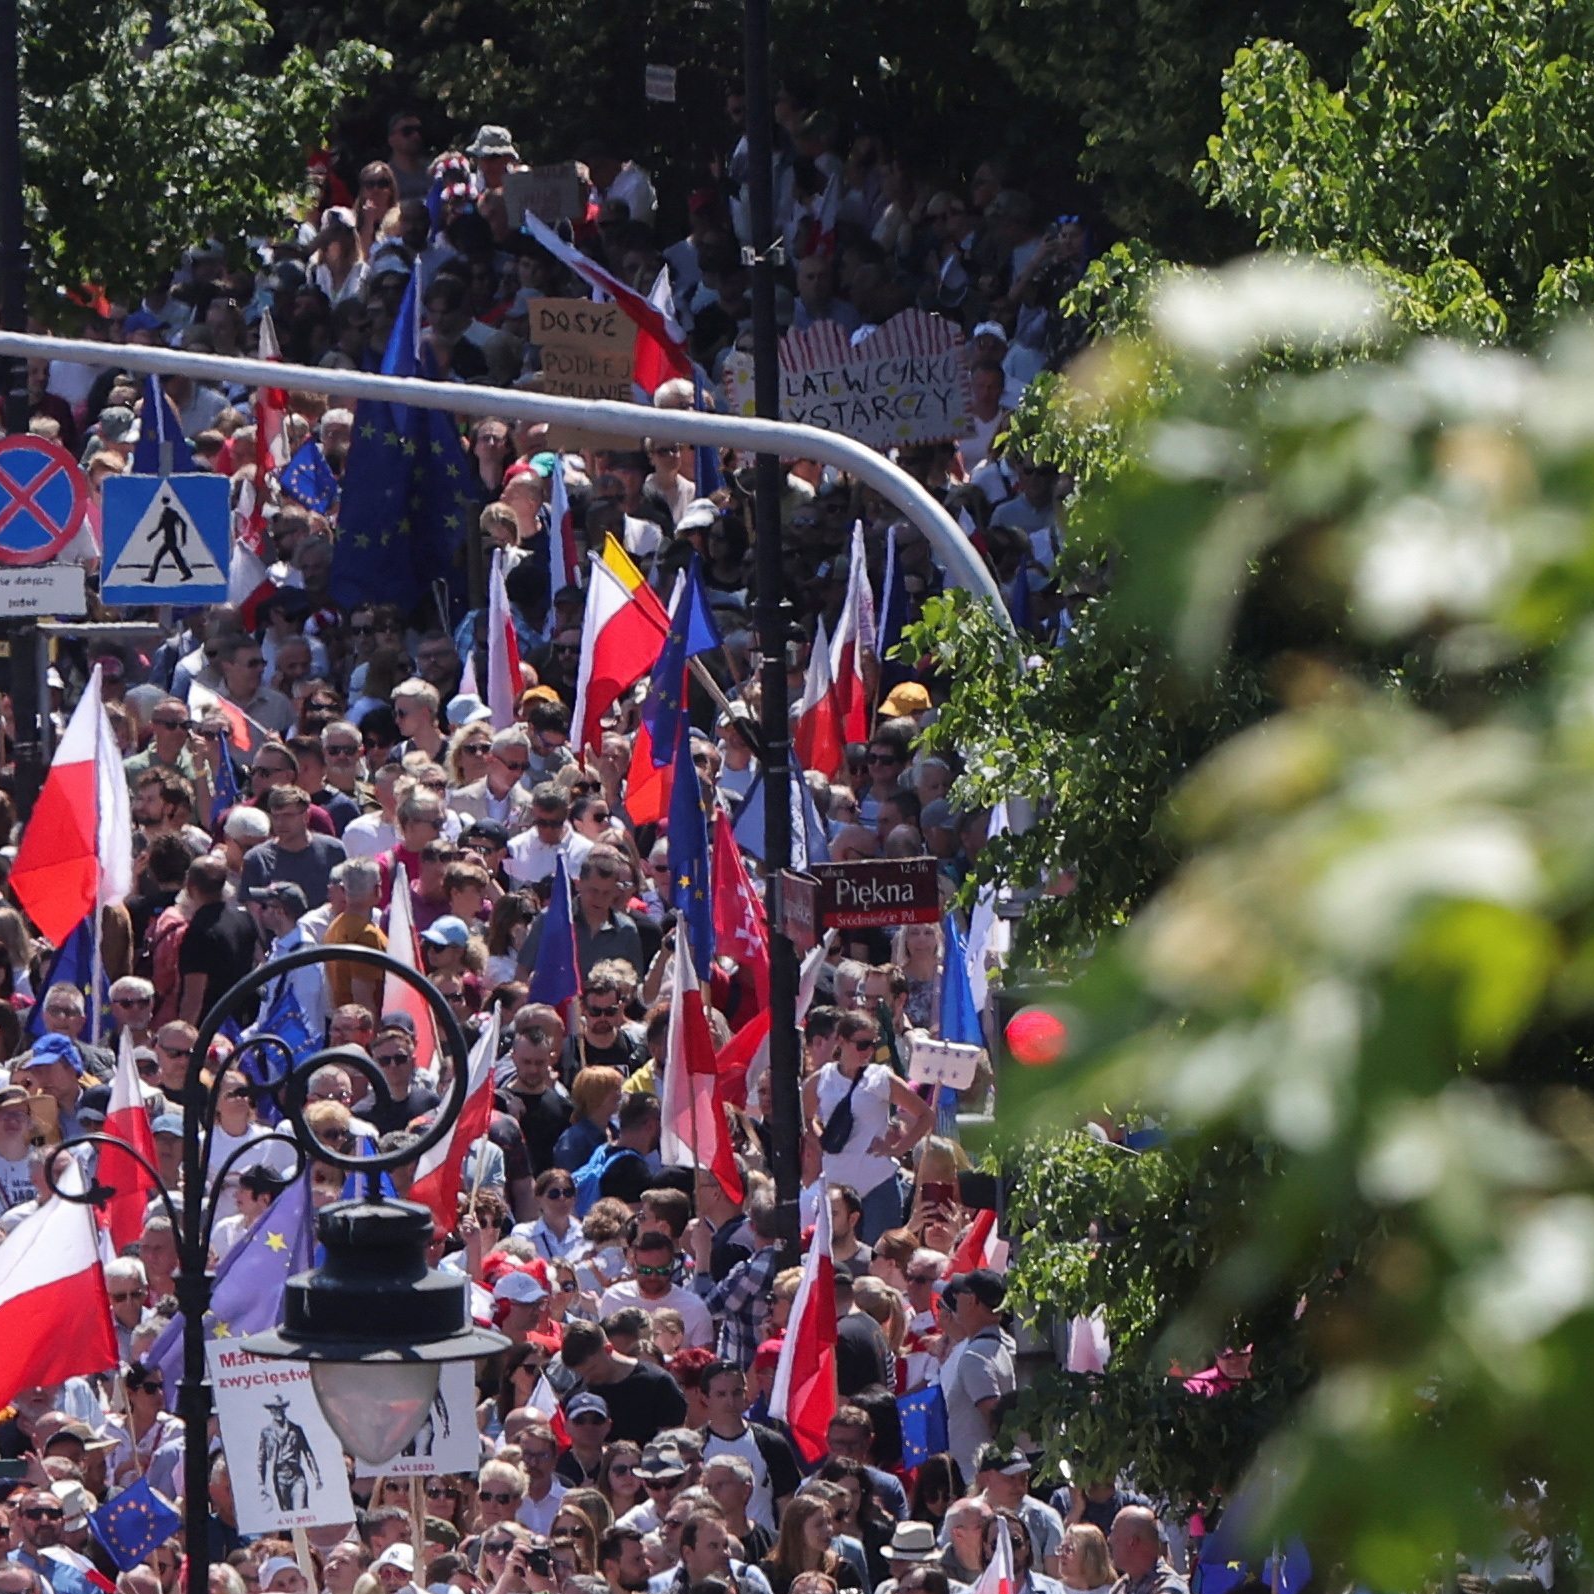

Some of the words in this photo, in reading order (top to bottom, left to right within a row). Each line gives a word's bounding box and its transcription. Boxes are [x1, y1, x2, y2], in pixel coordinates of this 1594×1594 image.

[540, 308, 618, 338] DOSYĆ
[786, 370, 835, 398] LAT
[842, 366, 870, 395] W
[875, 355, 958, 388] CYRKU
[780, 388, 953, 431] YSTARCZY
[835, 877, 915, 912] Piękna
[835, 912, 899, 928] Śródmieście
[900, 910, 919, 923] Pd.
[218, 1368, 313, 1389] zwycięstw
